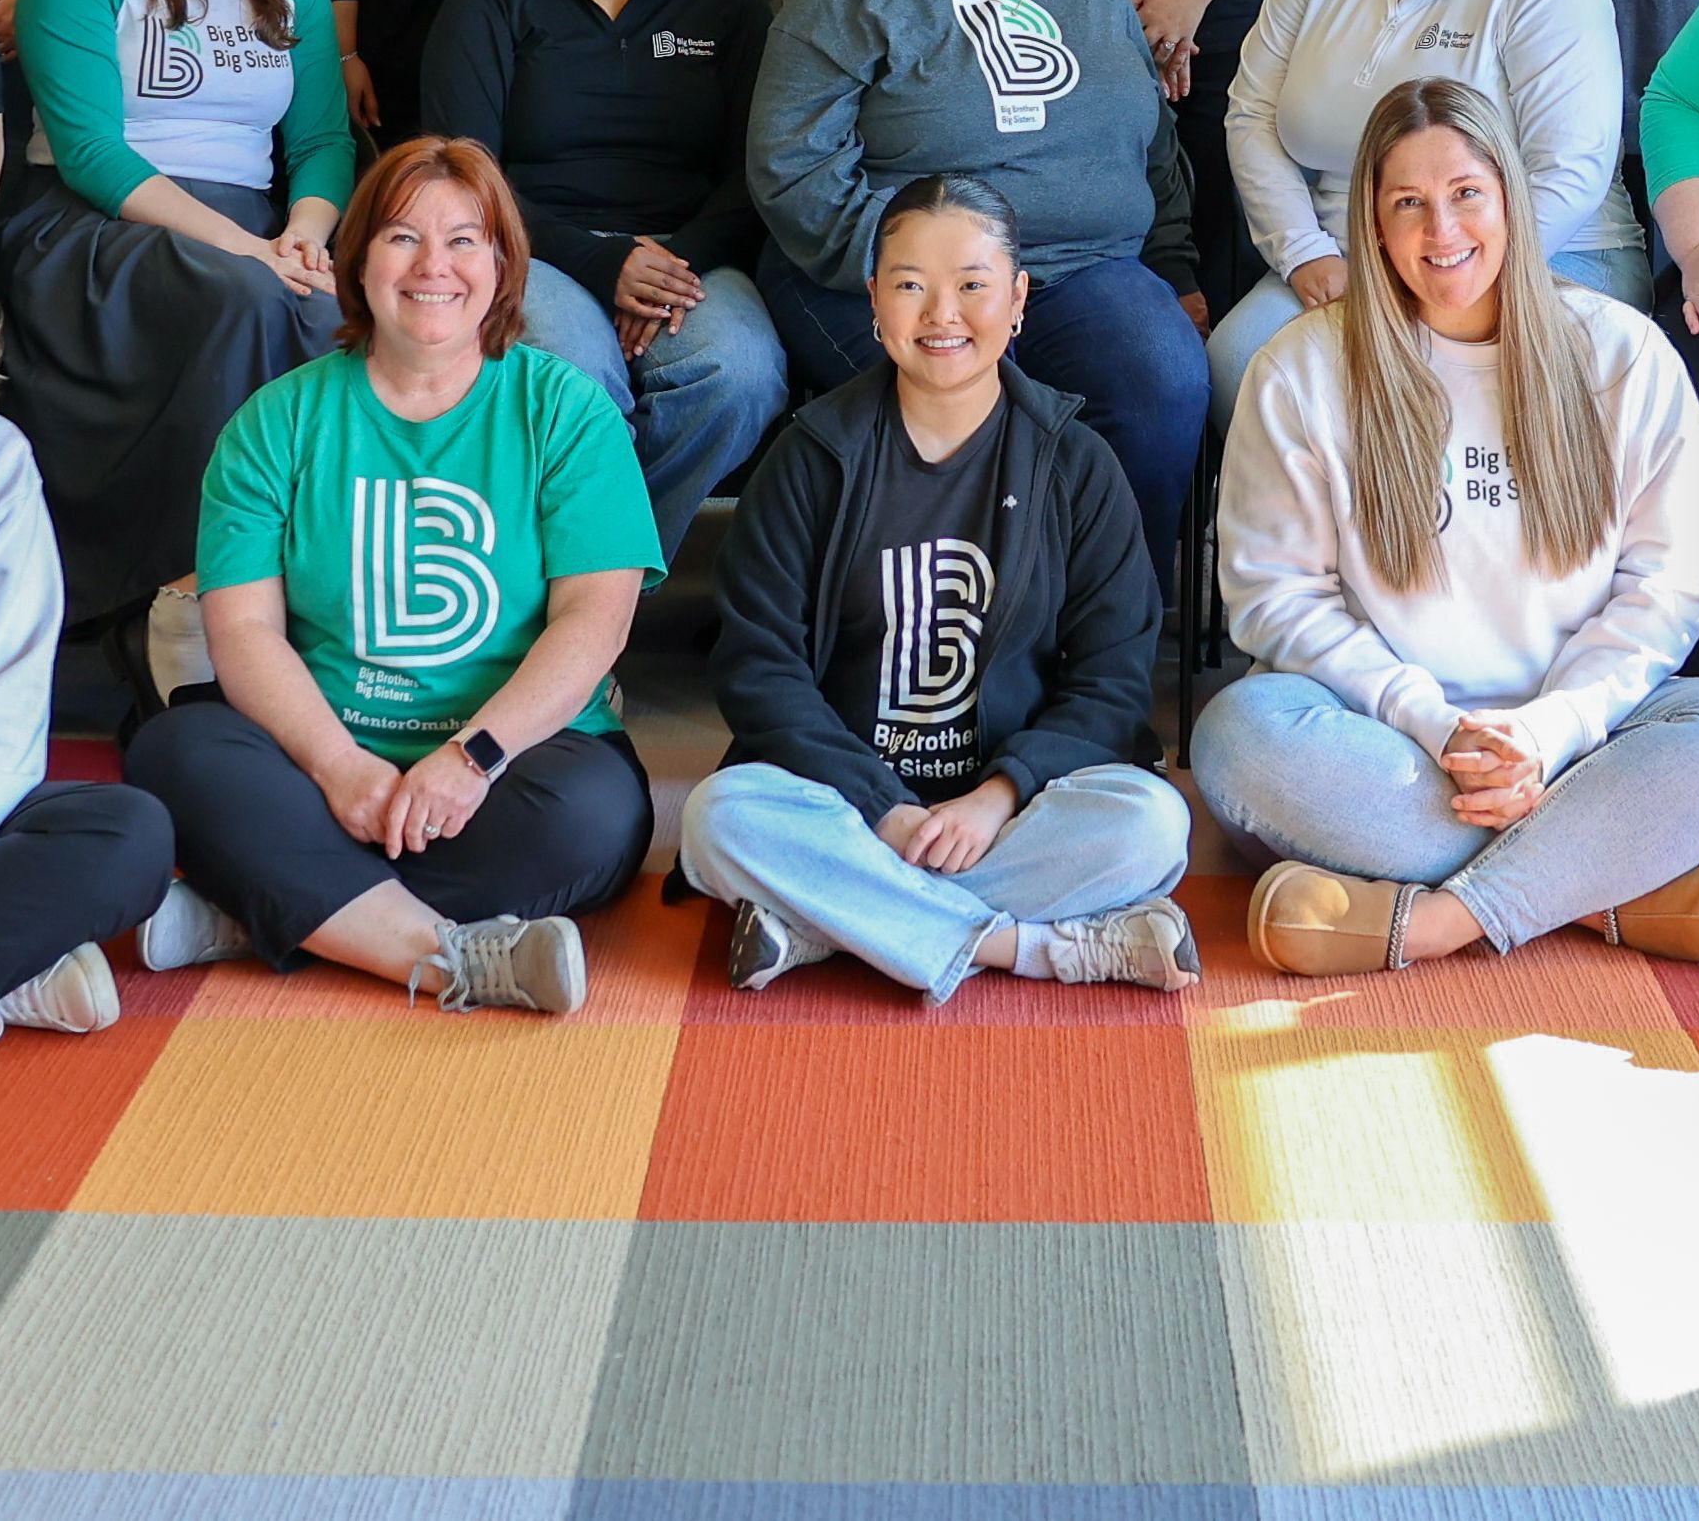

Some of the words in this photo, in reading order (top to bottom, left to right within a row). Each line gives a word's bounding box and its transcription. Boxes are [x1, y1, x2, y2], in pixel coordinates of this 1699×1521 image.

[206, 25, 236, 48] Big
[213, 49, 243, 74] Big
[245, 49, 290, 69] Sisters
[1465, 446, 1500, 475] Big
[1467, 479, 1501, 508] Big
[358, 666, 376, 684] Big
[355, 681, 373, 699] Big
[374, 685, 414, 703] Sisters.
[873, 723, 906, 755] Big
[903, 726, 980, 752] Brothe
